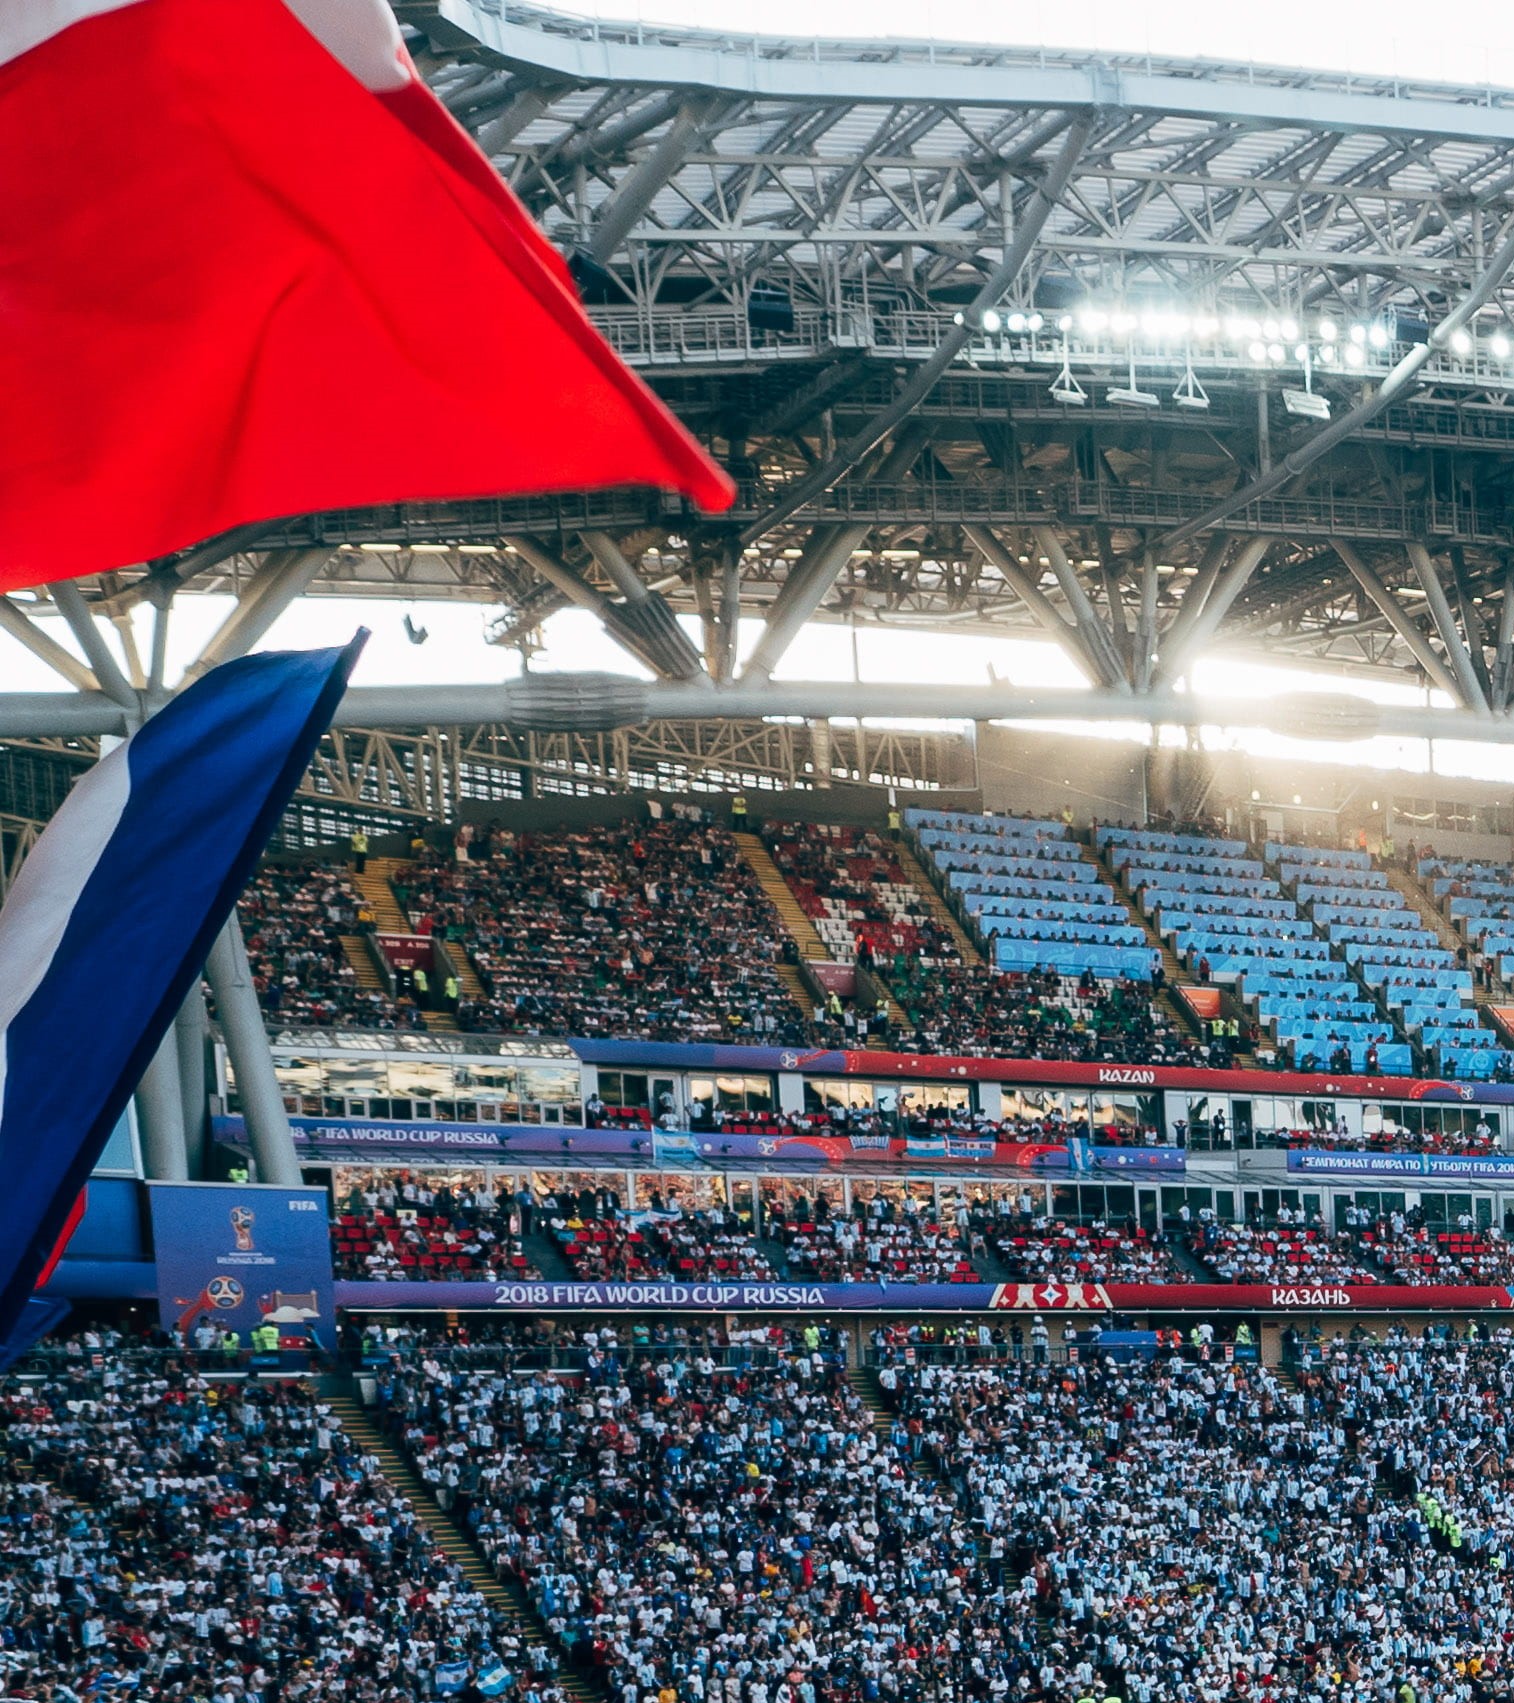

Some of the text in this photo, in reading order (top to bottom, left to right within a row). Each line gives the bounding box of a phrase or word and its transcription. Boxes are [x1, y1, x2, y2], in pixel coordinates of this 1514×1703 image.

[1099, 1068, 1155, 1084] KAZAN
[351, 1128, 408, 1143] WORLD
[409, 1130, 442, 1143] CUP
[443, 1131, 499, 1145] RUSSIA
[1371, 1157, 1403, 1171] МИРА
[1405, 1160, 1421, 1171] ПО
[1422, 1161, 1473, 1174] УТБОЛУ
[1474, 1162, 1496, 1173] FIFA
[288, 1200, 318, 1211] FIFA
[495, 1286, 825, 1305] 2018 FIFA WORLD CUP RUSSIA
[1271, 1289, 1350, 1306] КАЗАНЬ
